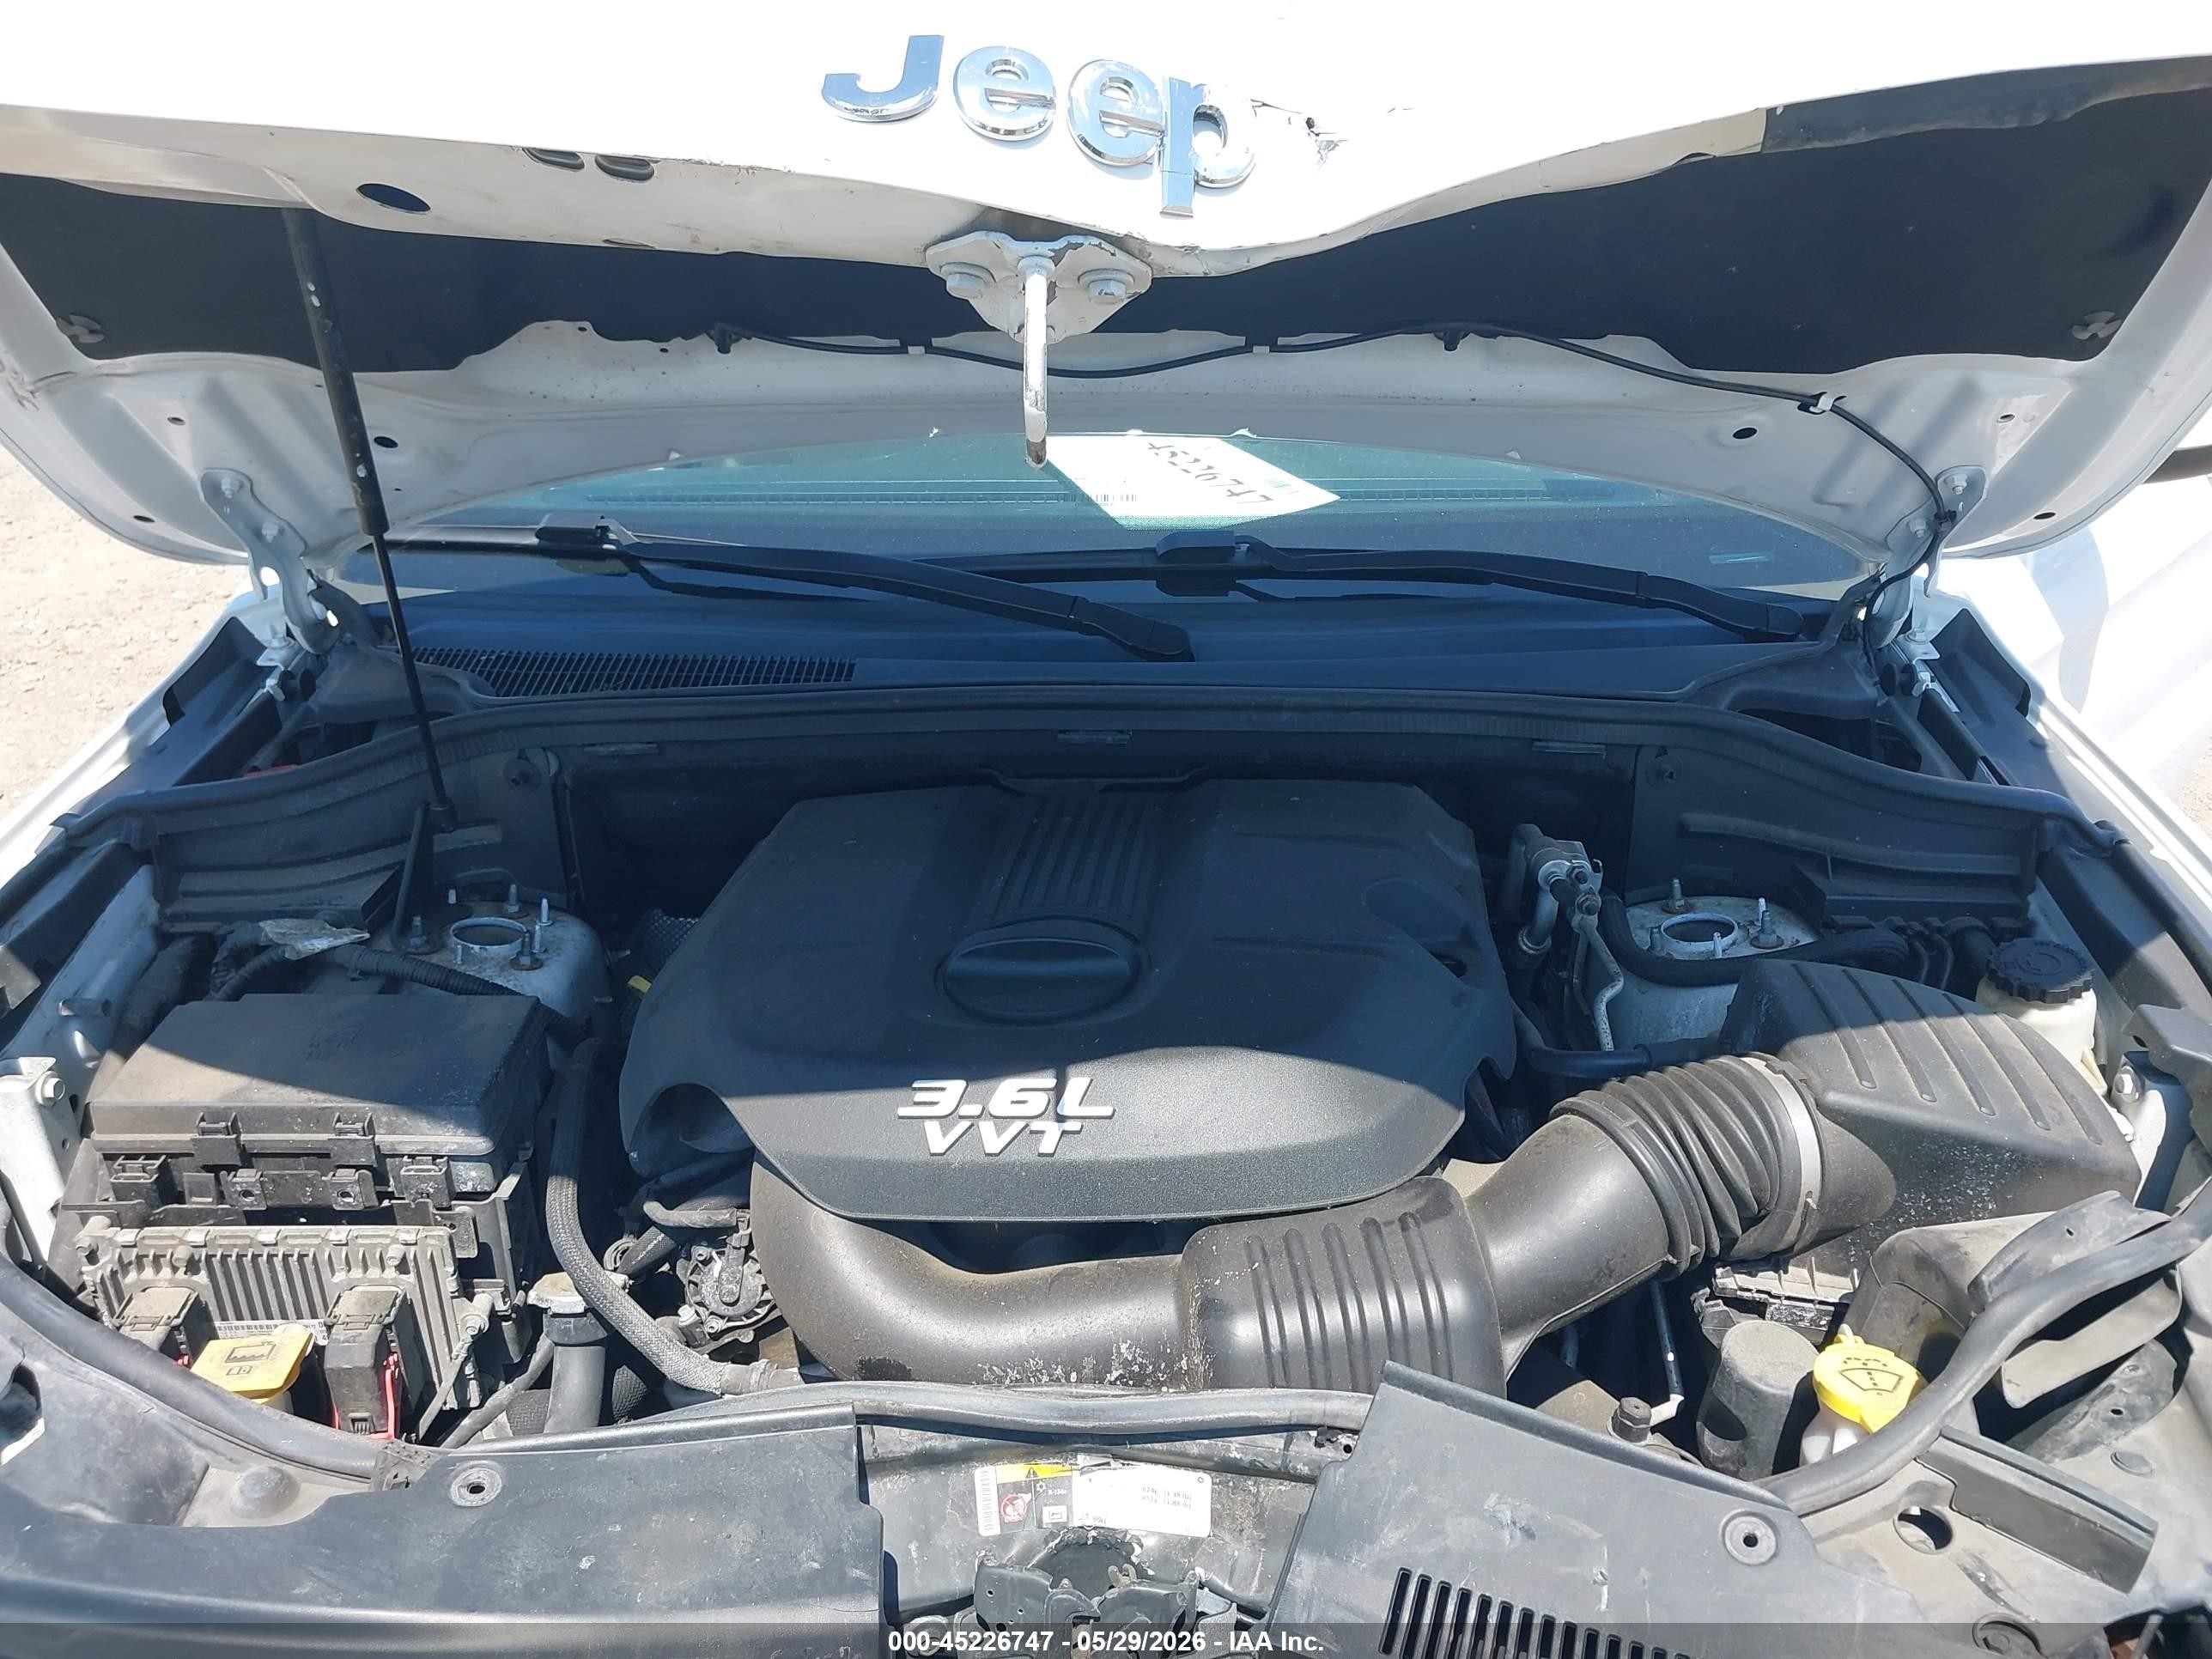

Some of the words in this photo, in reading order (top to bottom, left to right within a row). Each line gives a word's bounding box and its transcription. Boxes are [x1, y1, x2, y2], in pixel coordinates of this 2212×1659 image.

[821, 35, 1255, 217] Jeep
[897, 1077, 1116, 1119] 3.6L
[923, 1121, 1084, 1158] VVT
